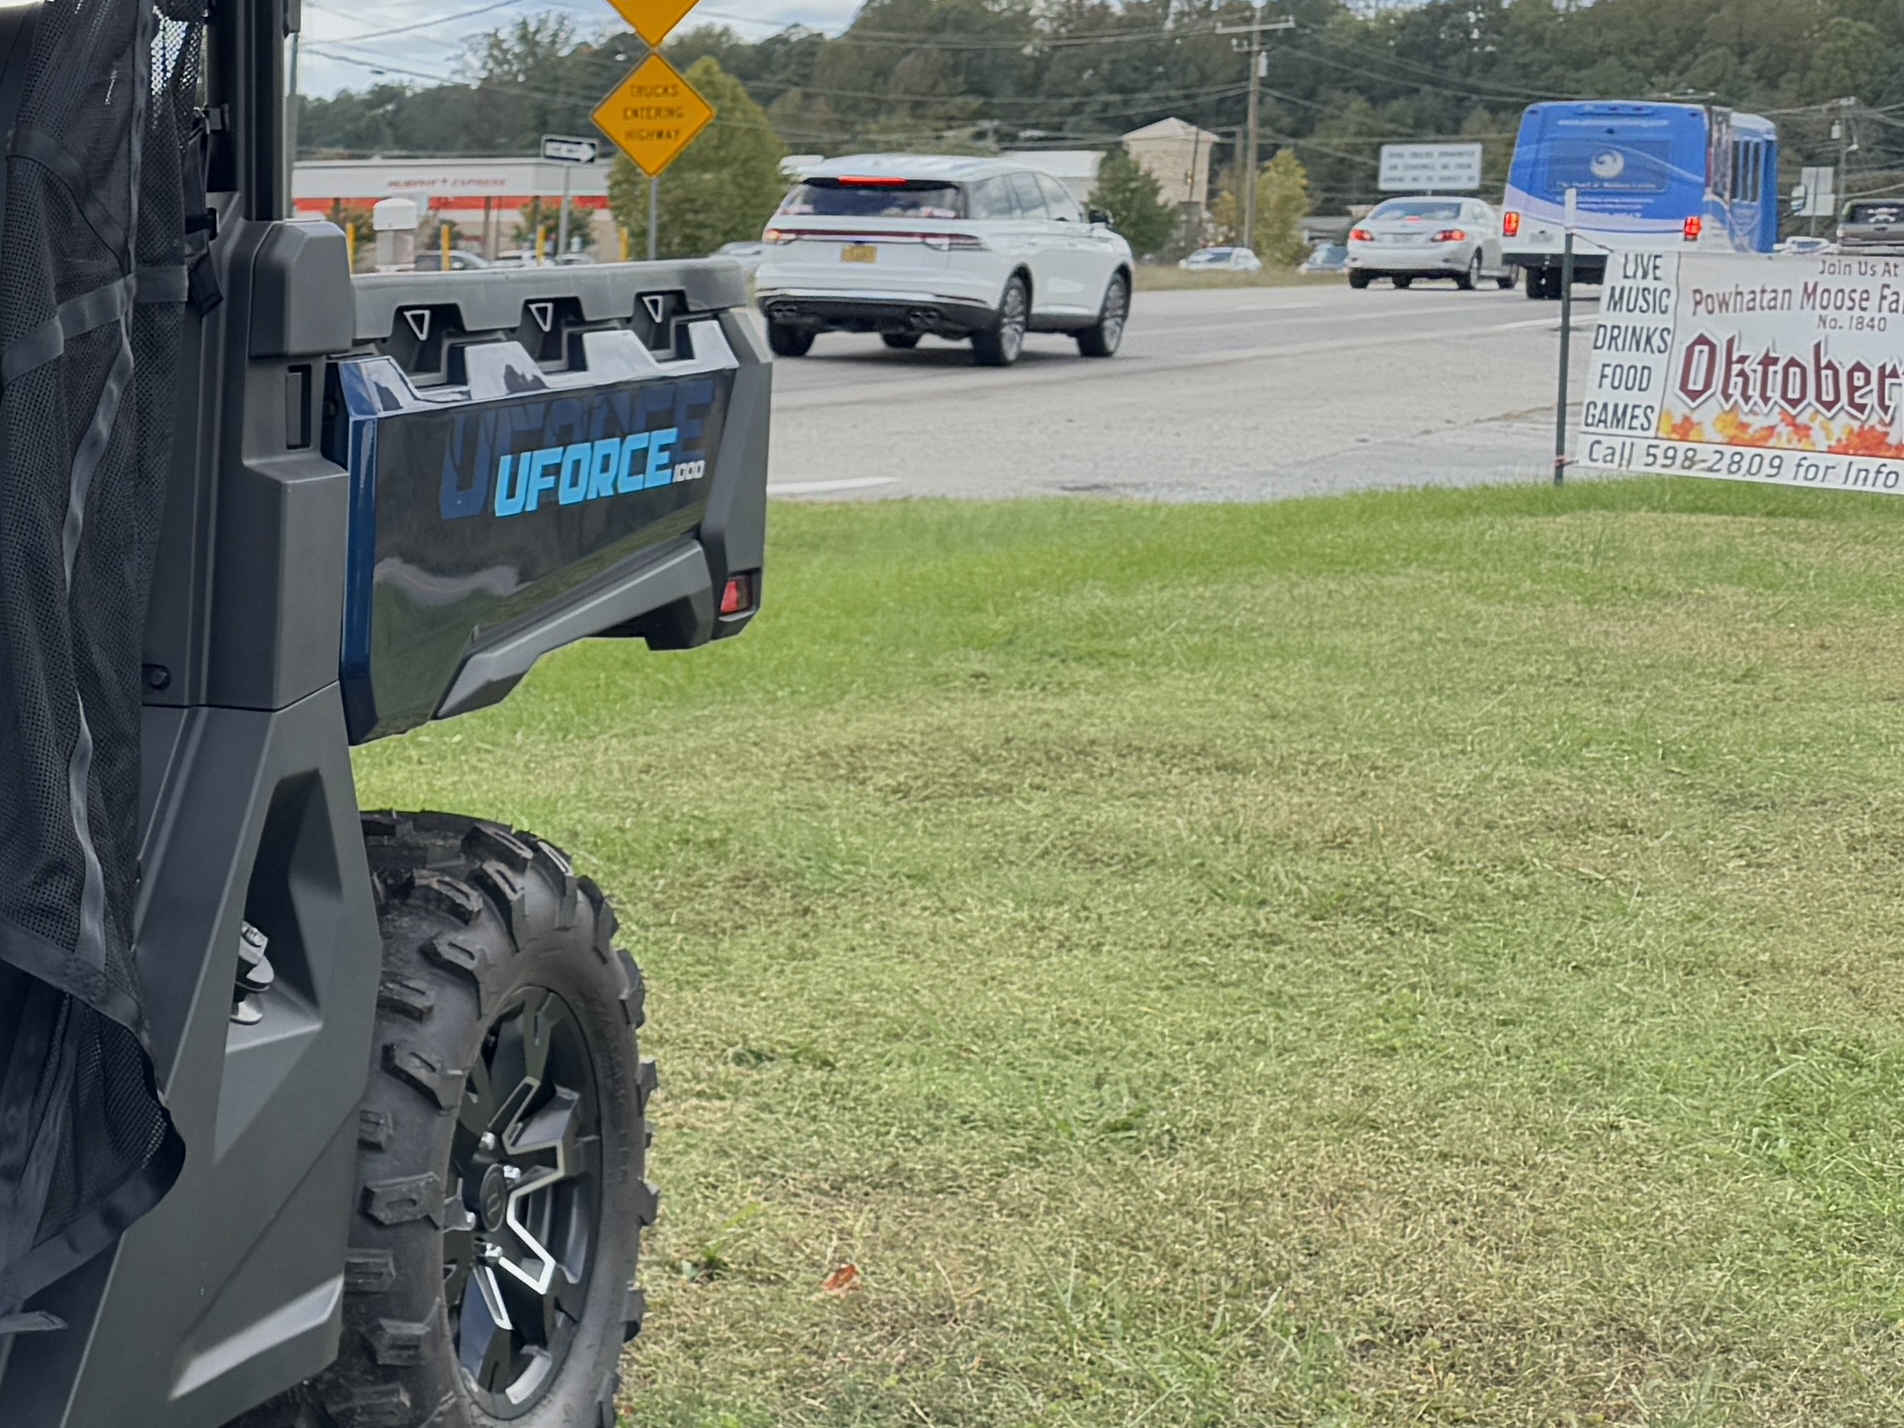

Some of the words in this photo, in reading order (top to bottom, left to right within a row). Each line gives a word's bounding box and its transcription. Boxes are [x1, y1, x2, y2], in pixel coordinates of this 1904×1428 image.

[630, 83, 679, 97] TRUCKS
[623, 105, 684, 121] ENTERING
[624, 128, 681, 142] HIGHWAY
[1622, 253, 1663, 281] LIVE
[1818, 259, 1852, 276] Join
[1857, 260, 1877, 277] Us
[1881, 261, 1899, 278] At
[1606, 285, 1672, 315] MUSIC
[1691, 283, 1792, 316] Powhatan
[1799, 281, 1871, 311] Moose
[1877, 282, 1904, 315] Fa
[1816, 314, 1844, 330] No.
[1848, 315, 1888, 332] 1840
[1592, 323, 1672, 355] DRINKS
[1598, 362, 1653, 392] FOOD
[1677, 330, 1904, 423] Oktober
[1583, 400, 1655, 432] GAMES
[494, 427, 679, 518] UFORCE
[672, 459, 706, 483] 1000
[1588, 439, 1635, 469] Call
[1642, 443, 1785, 479] 598-2809
[1793, 456, 1837, 483] for
[1841, 460, 1900, 489] Info
